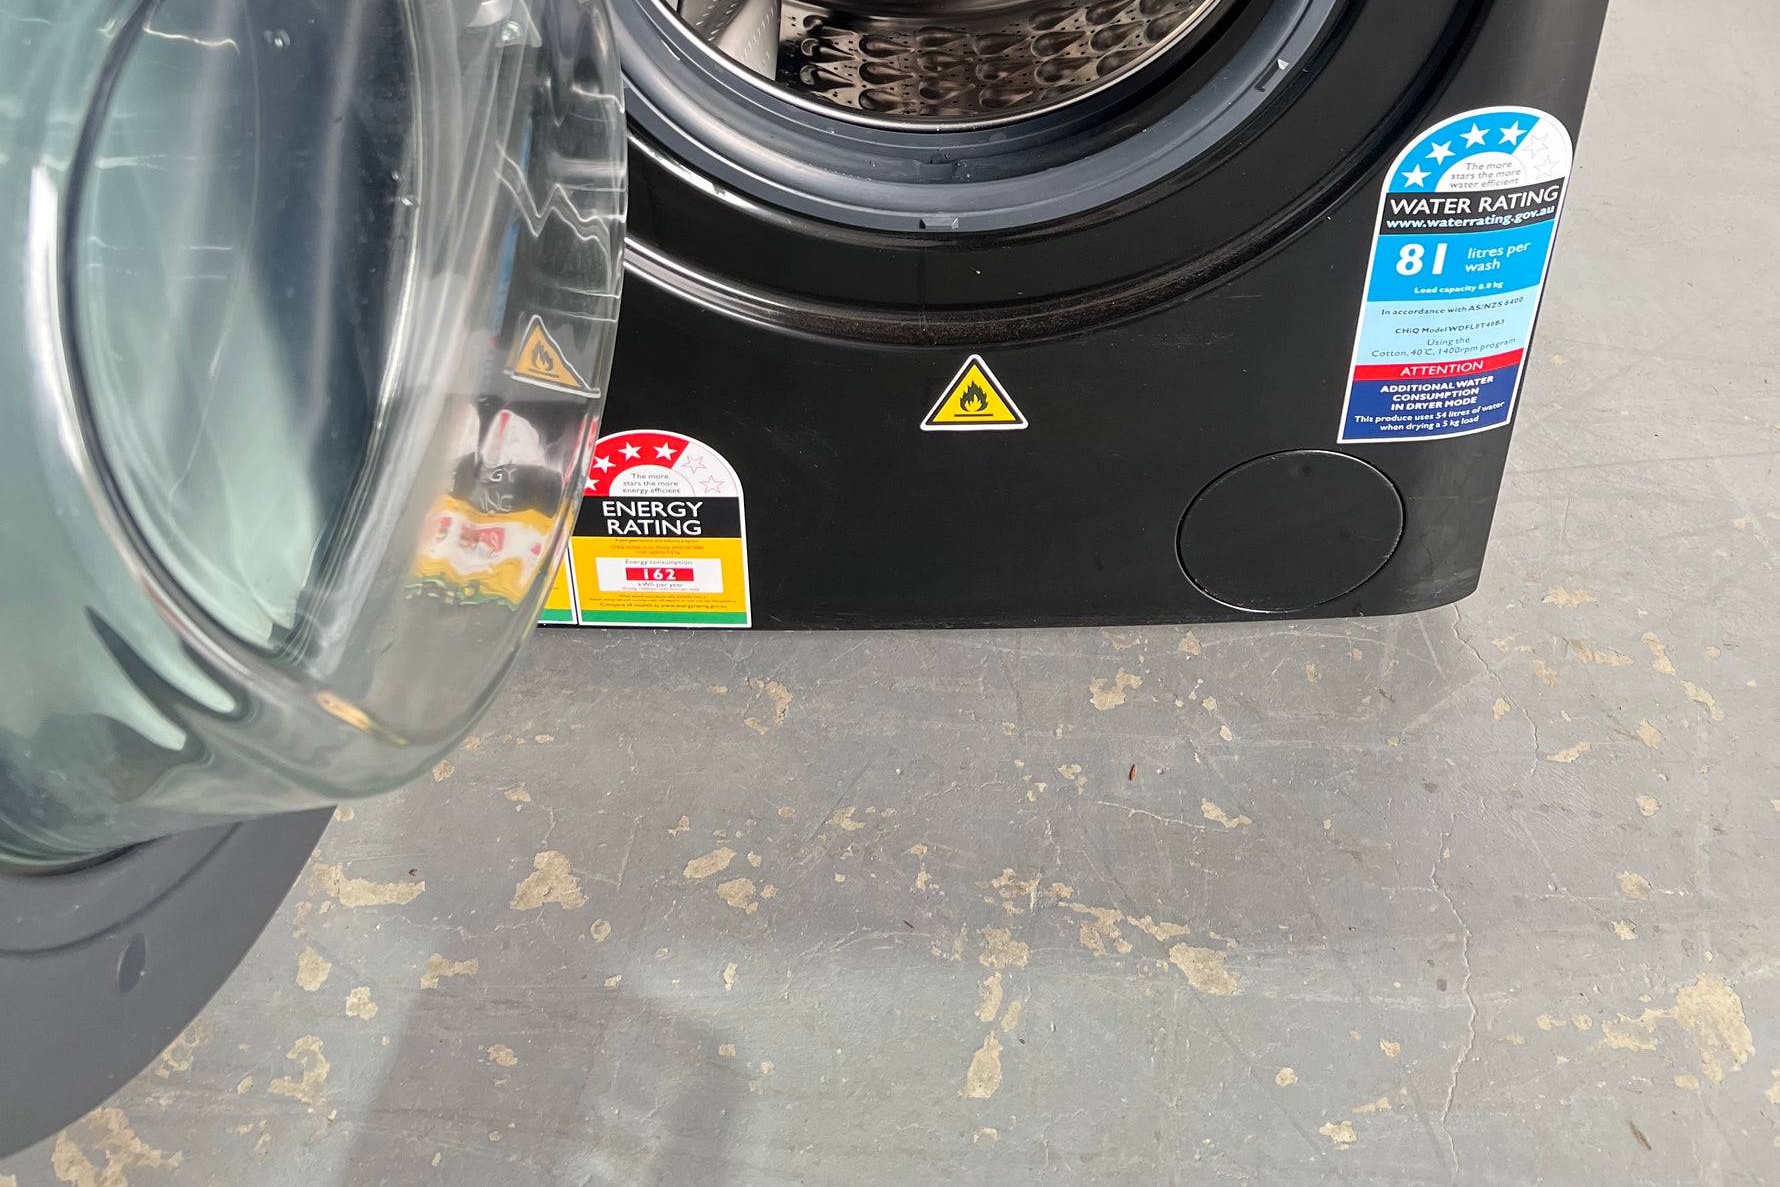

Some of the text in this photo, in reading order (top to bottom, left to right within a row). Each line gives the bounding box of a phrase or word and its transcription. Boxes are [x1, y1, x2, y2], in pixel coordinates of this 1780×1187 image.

[1465, 161, 1513, 171] The more
[1451, 169, 1521, 180] stars the more
[1449, 178, 1519, 189] water efficient
[1390, 185, 1560, 215] WATER RATING
[1386, 205, 1556, 229] www.waterrating.gov.au
[1467, 242, 1532, 260] litres per
[1465, 259, 1501, 273] wash
[1414, 286, 1438, 294] Load
[1439, 285, 1477, 296] capacity
[1493, 281, 1504, 290] kg
[1392, 308, 1446, 316] accordance
[1448, 306, 1467, 314] with
[1467, 301, 1503, 313] AS/NZS
[1504, 296, 1524, 307] 6400
[1395, 326, 1419, 335] CHiQ
[1421, 325, 1448, 334] Model
[1371, 349, 1409, 358] Cotton,
[1438, 345, 1478, 356] 1400rpm
[1480, 337, 1517, 352] program
[1427, 337, 1471, 347] Using the
[1400, 360, 1484, 377] ATTENTION
[1380, 375, 1495, 393] ADDITIONAL WATER
[1392, 387, 1480, 402] CONSUMPTION
[1390, 396, 1478, 411] IN DRYER MODE
[1354, 415, 1374, 423] This
[1375, 415, 1413, 424] produce
[1448, 409, 1470, 418] litres
[1471, 406, 1482, 414] of
[1481, 401, 1506, 412] water
[1380, 423, 1405, 431] when
[1405, 422, 1435, 432] drying
[1449, 419, 1460, 428] kg
[1461, 416, 1480, 425] load
[602, 500, 704, 518] ENERGY
[607, 518, 702, 536] RATING
[625, 558, 648, 566] Energy
[642, 567, 677, 581] 162
